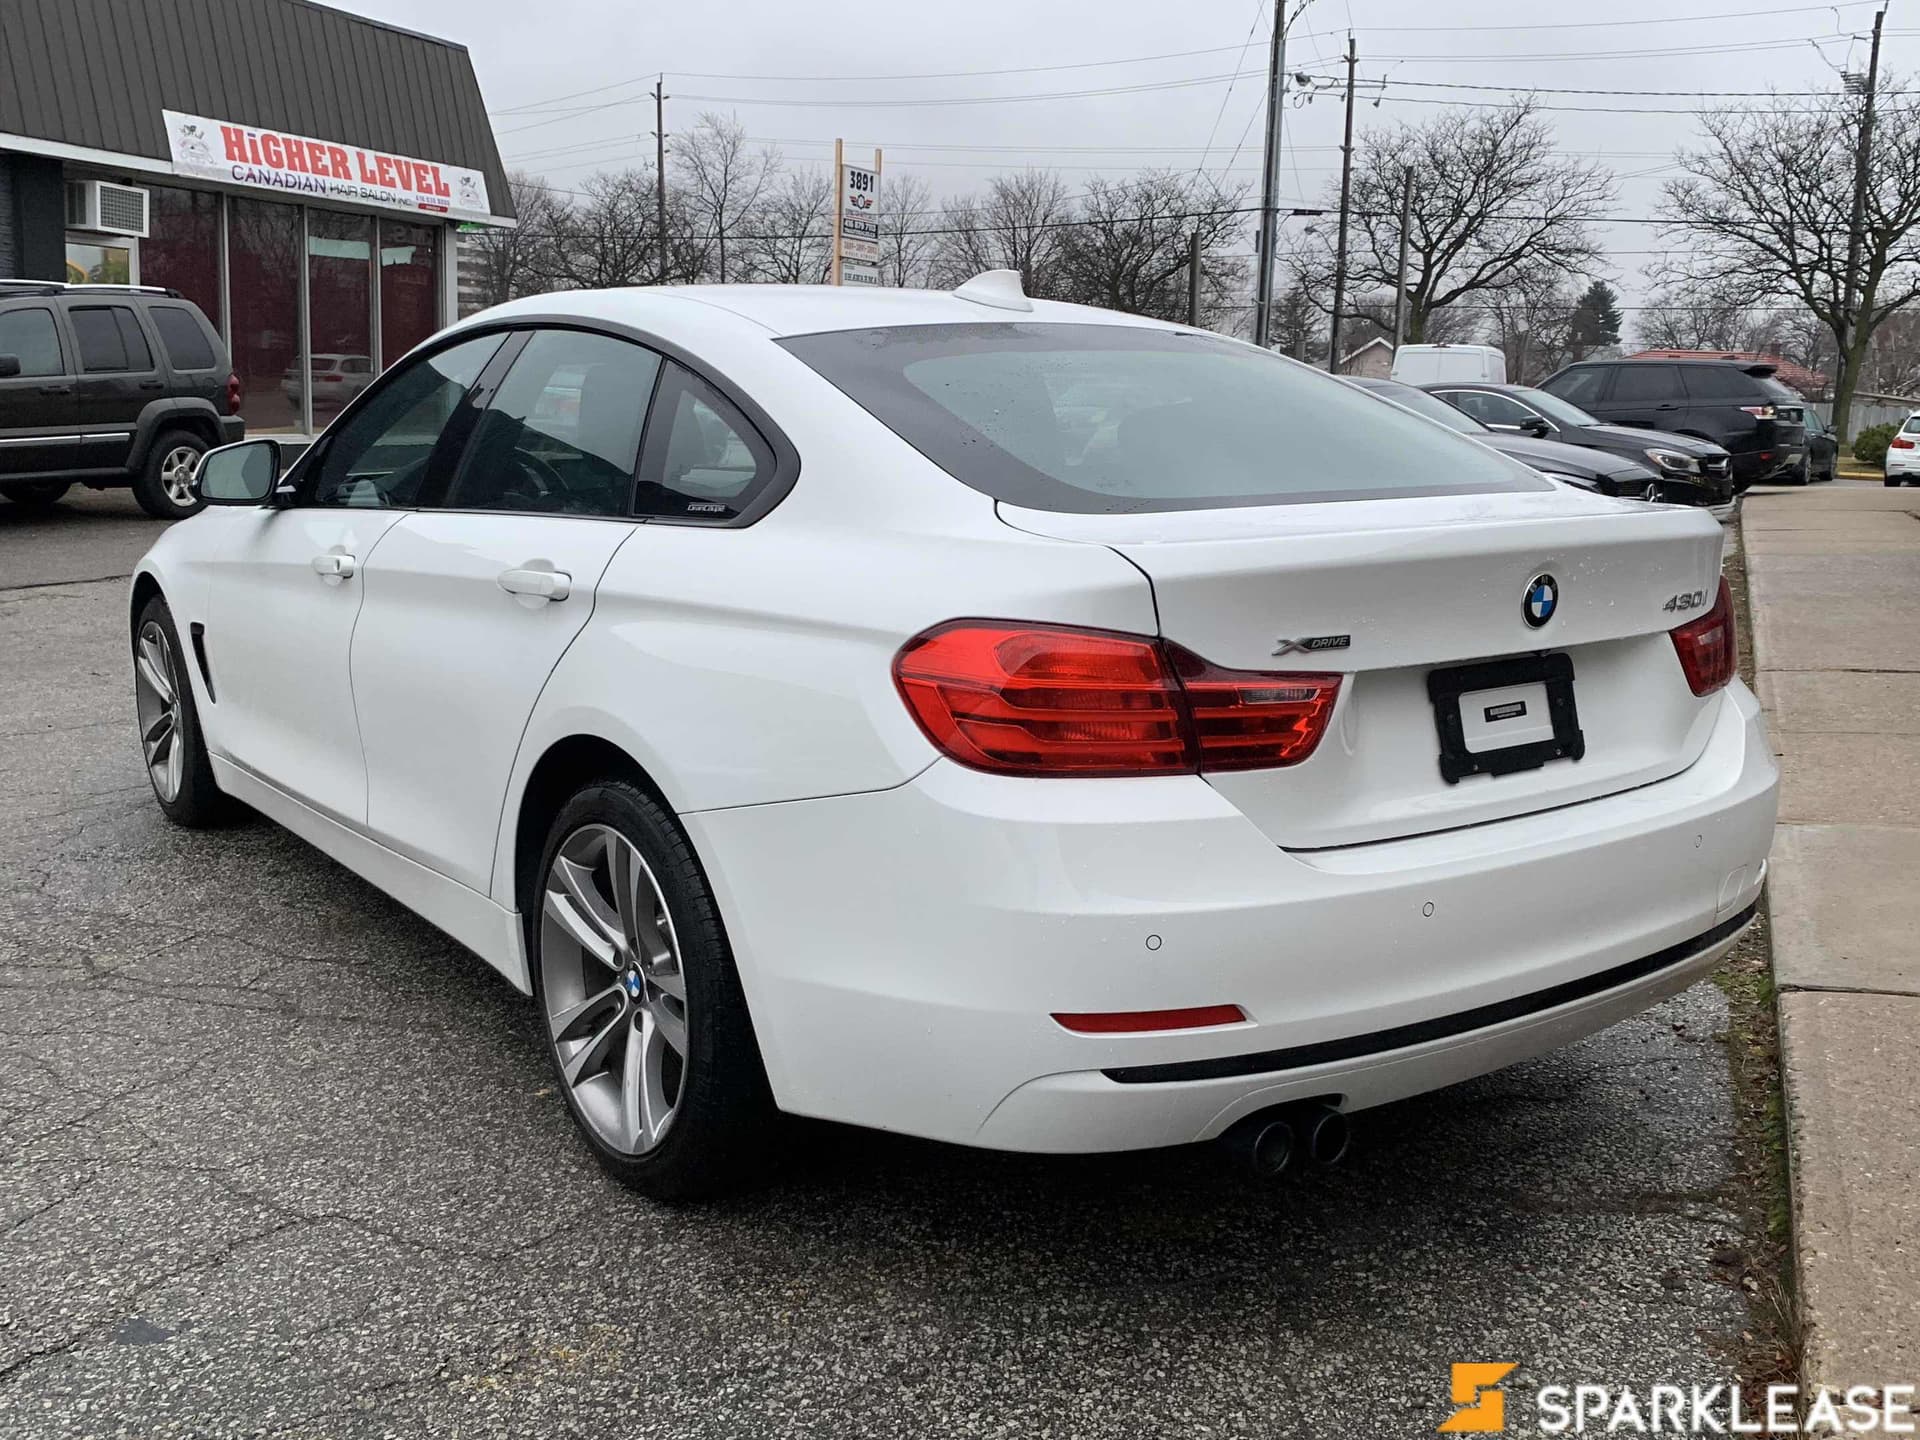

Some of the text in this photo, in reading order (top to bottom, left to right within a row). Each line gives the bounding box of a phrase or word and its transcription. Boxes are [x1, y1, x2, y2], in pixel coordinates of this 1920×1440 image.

[231, 165, 327, 194] CANADIAN
[329, 182, 358, 198] HAIR
[359, 186, 396, 203] SALON
[356, 151, 450, 197] LEVEL
[850, 170, 874, 192] 3891
